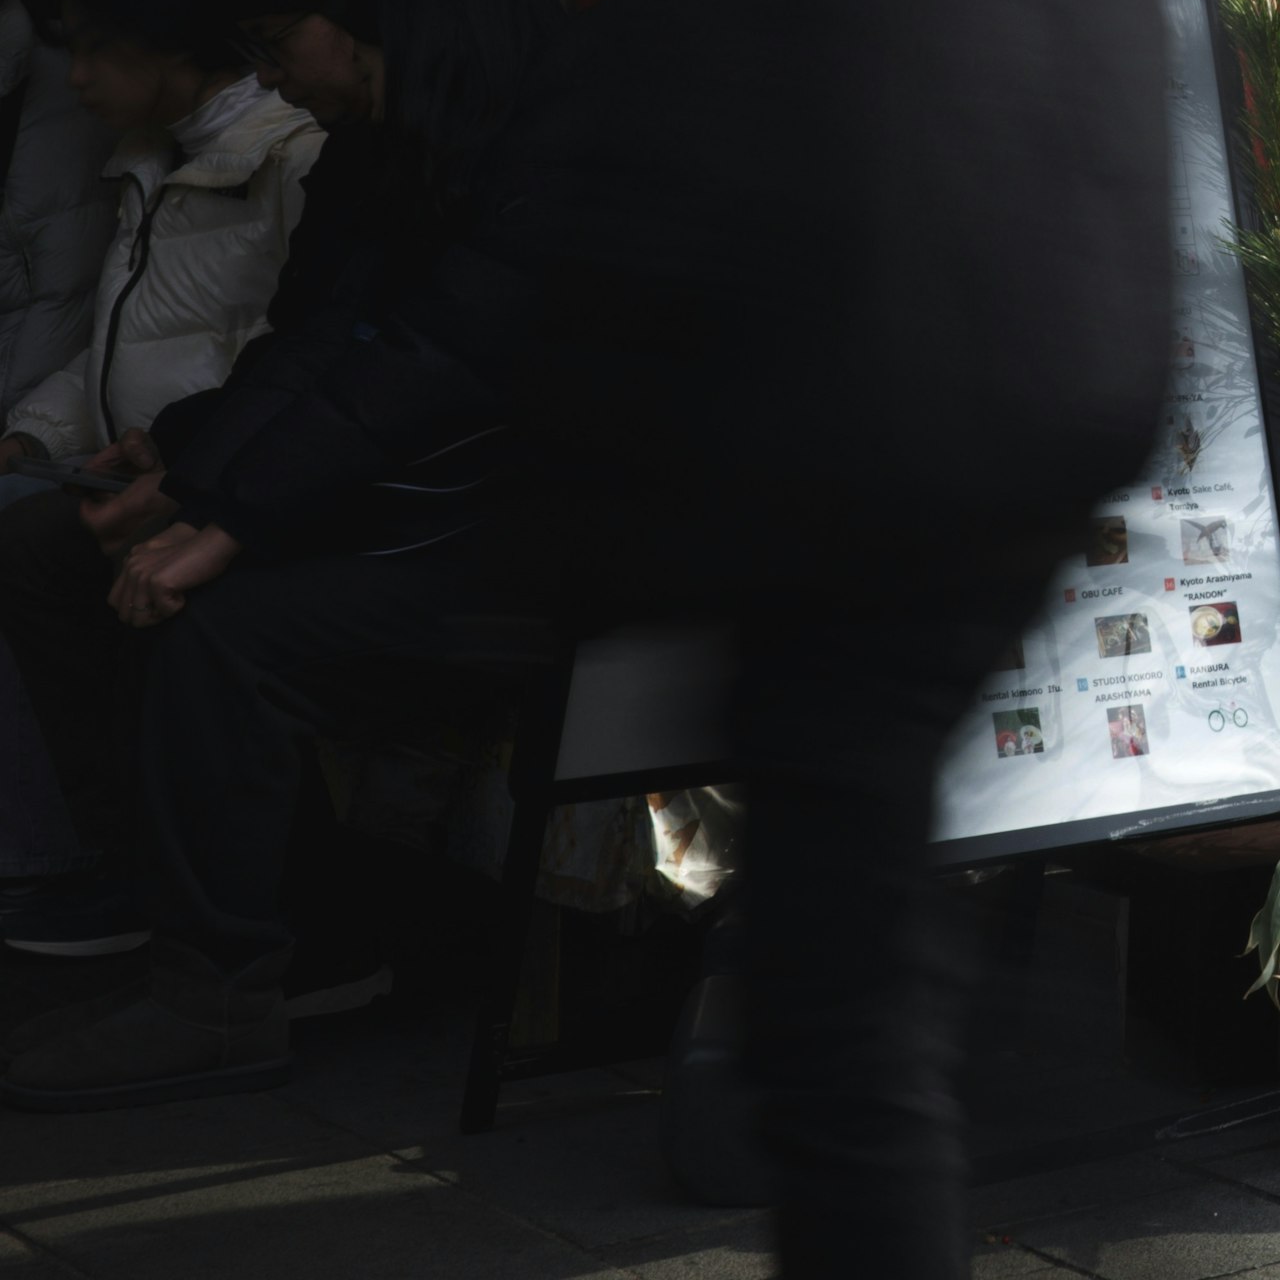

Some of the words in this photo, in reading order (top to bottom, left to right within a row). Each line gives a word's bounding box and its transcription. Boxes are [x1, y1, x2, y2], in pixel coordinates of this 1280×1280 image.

[1167, 487, 1190, 497] Kyoto
[1192, 484, 1213, 495] Sake
[1168, 502, 1199, 512] Tomiya
[1180, 577, 1204, 588] Kyoto
[1205, 571, 1252, 585] Arashiyama
[1081, 590, 1100, 600] OBU
[1189, 663, 1230, 675] RANBURA
[1092, 675, 1127, 687] STUDIO
[1127, 670, 1163, 683] KOKORO
[1192, 679, 1218, 690] Rental
[1219, 675, 1248, 687] Bicycle
[1010, 686, 1044, 698] kimono
[1095, 688, 1152, 703] ARASHIYAMA
